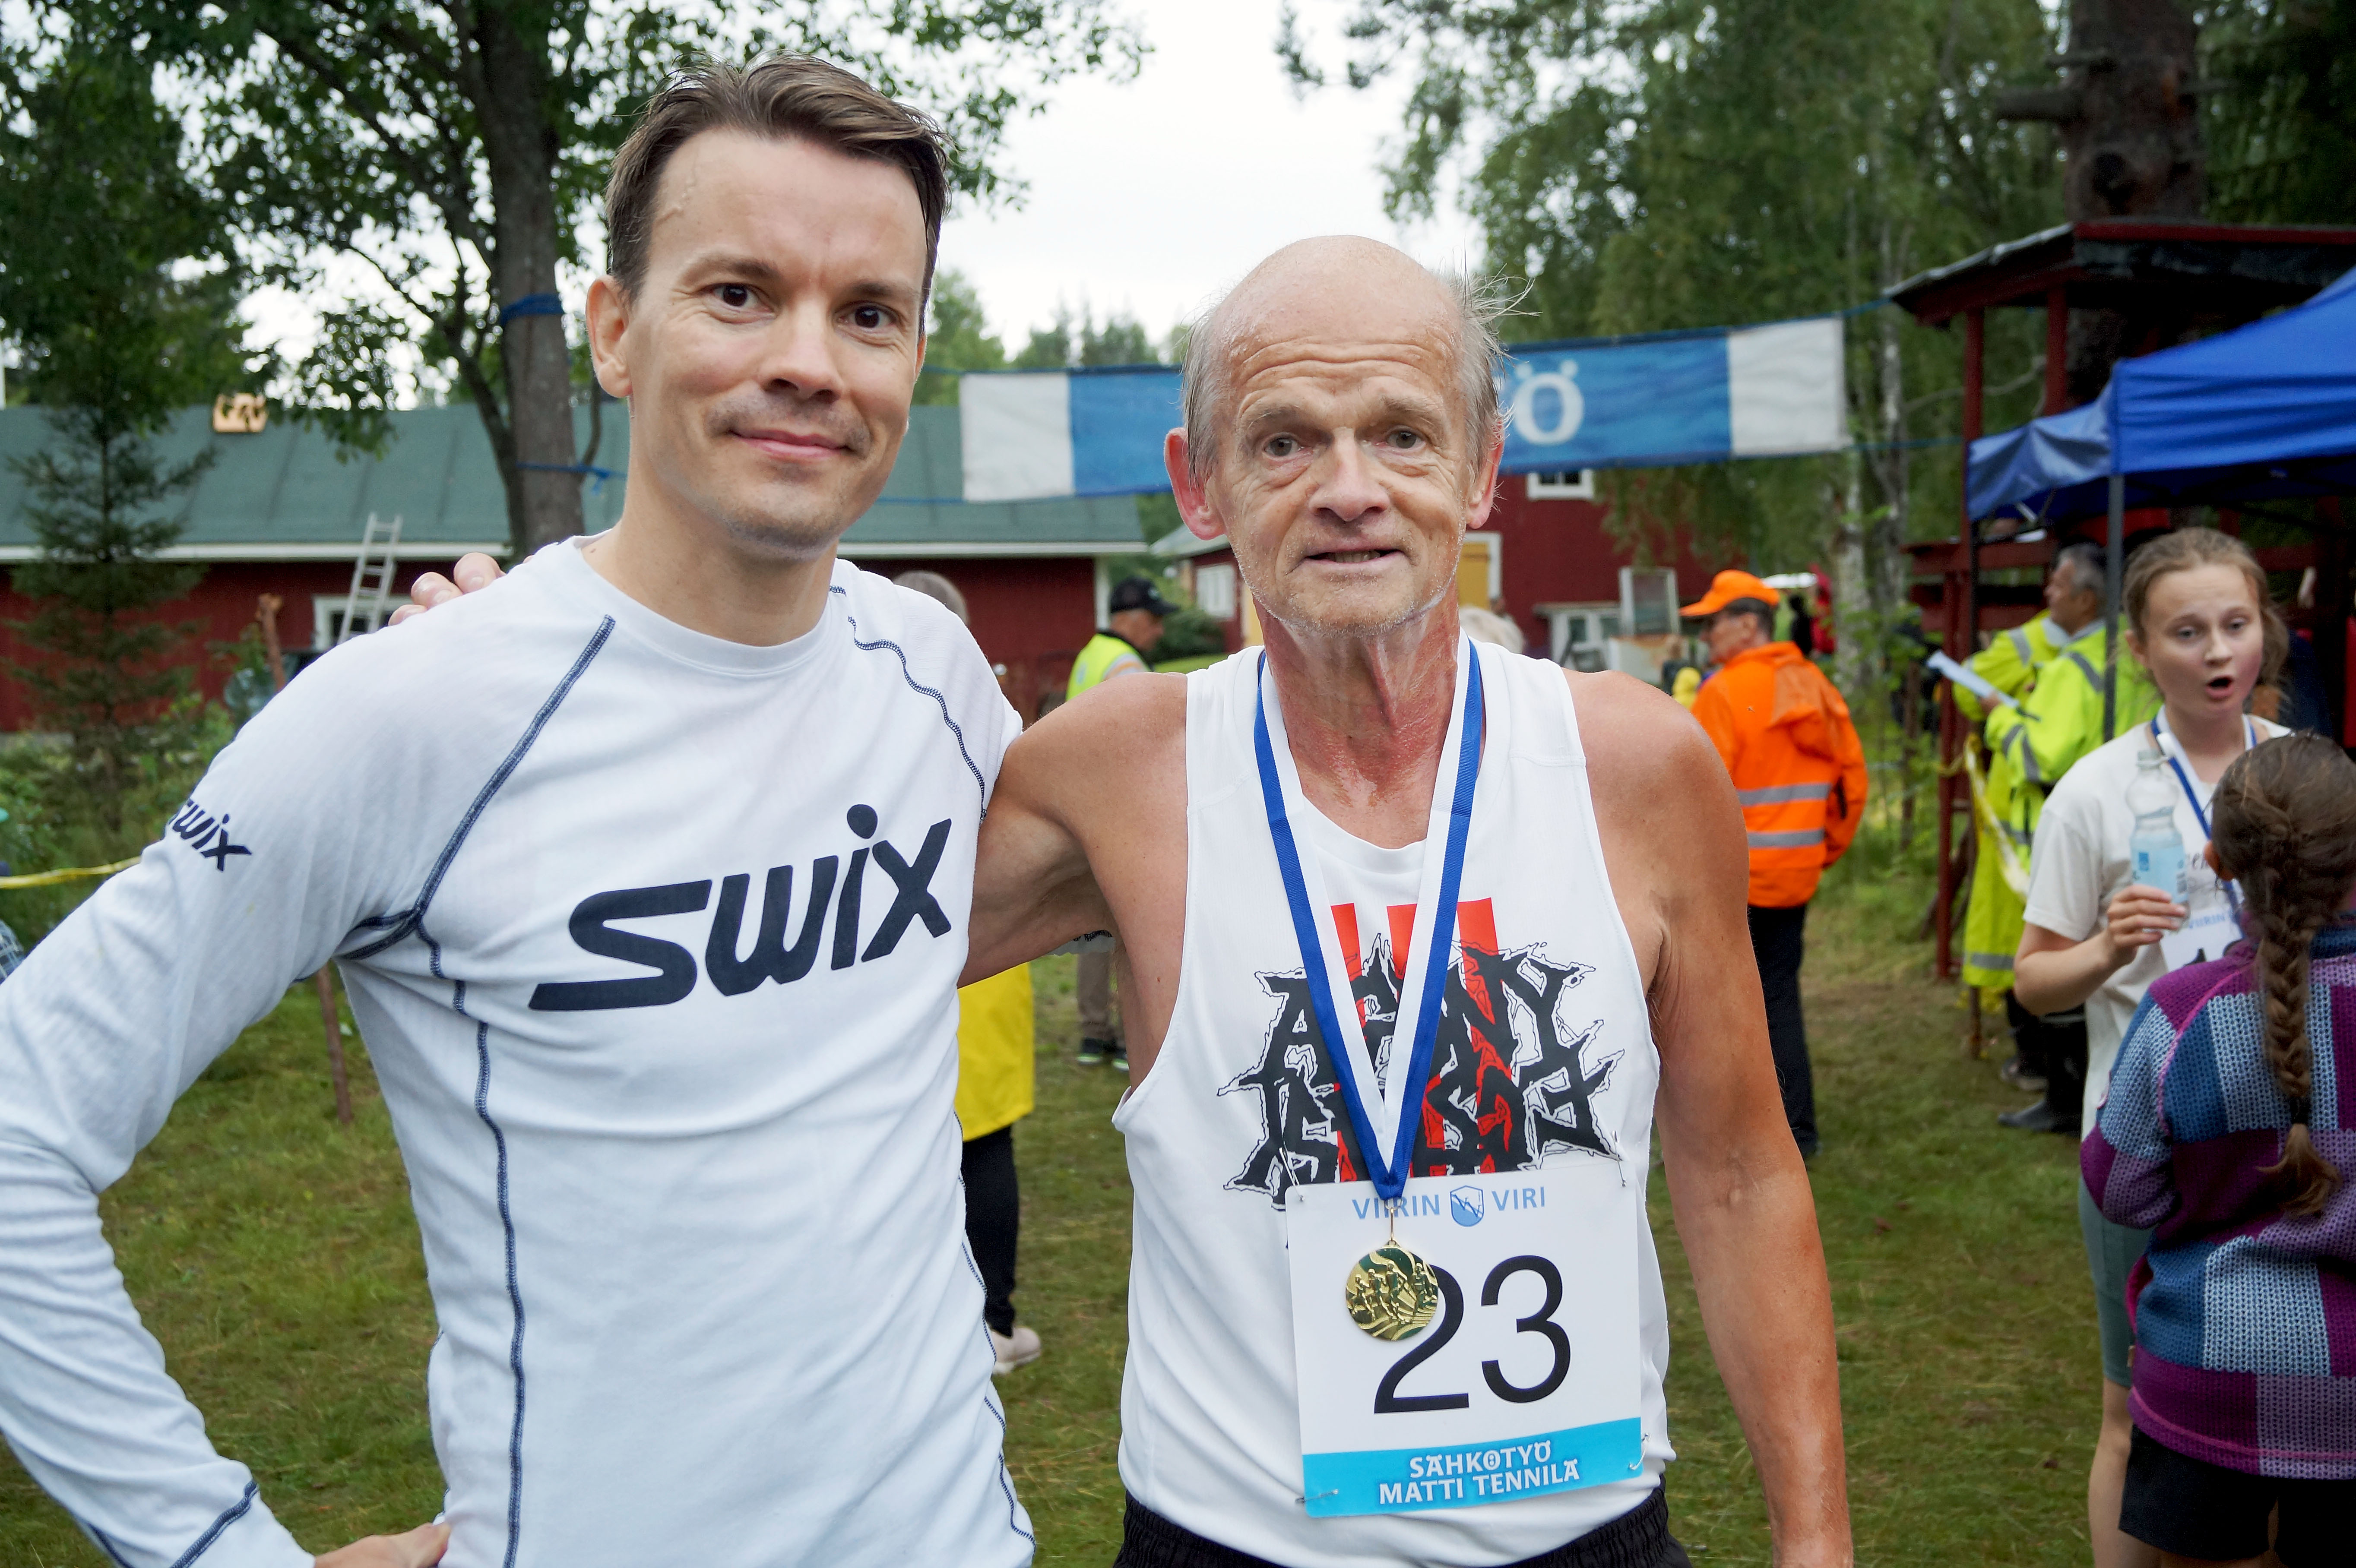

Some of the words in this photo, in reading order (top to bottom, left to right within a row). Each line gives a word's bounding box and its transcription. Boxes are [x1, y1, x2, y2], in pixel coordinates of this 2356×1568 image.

[1507, 360, 1584, 446] Ö
[1352, 1194, 1441, 1220] VIIRIN
[1492, 1186, 1545, 1211] VIRI
[1373, 1254, 1571, 1414] 23
[1379, 1478, 1463, 1505] MATTI
[1472, 1458, 1580, 1496] TENNILÄ
[1409, 1440, 1552, 1478] SÄHKÖTYÖ
